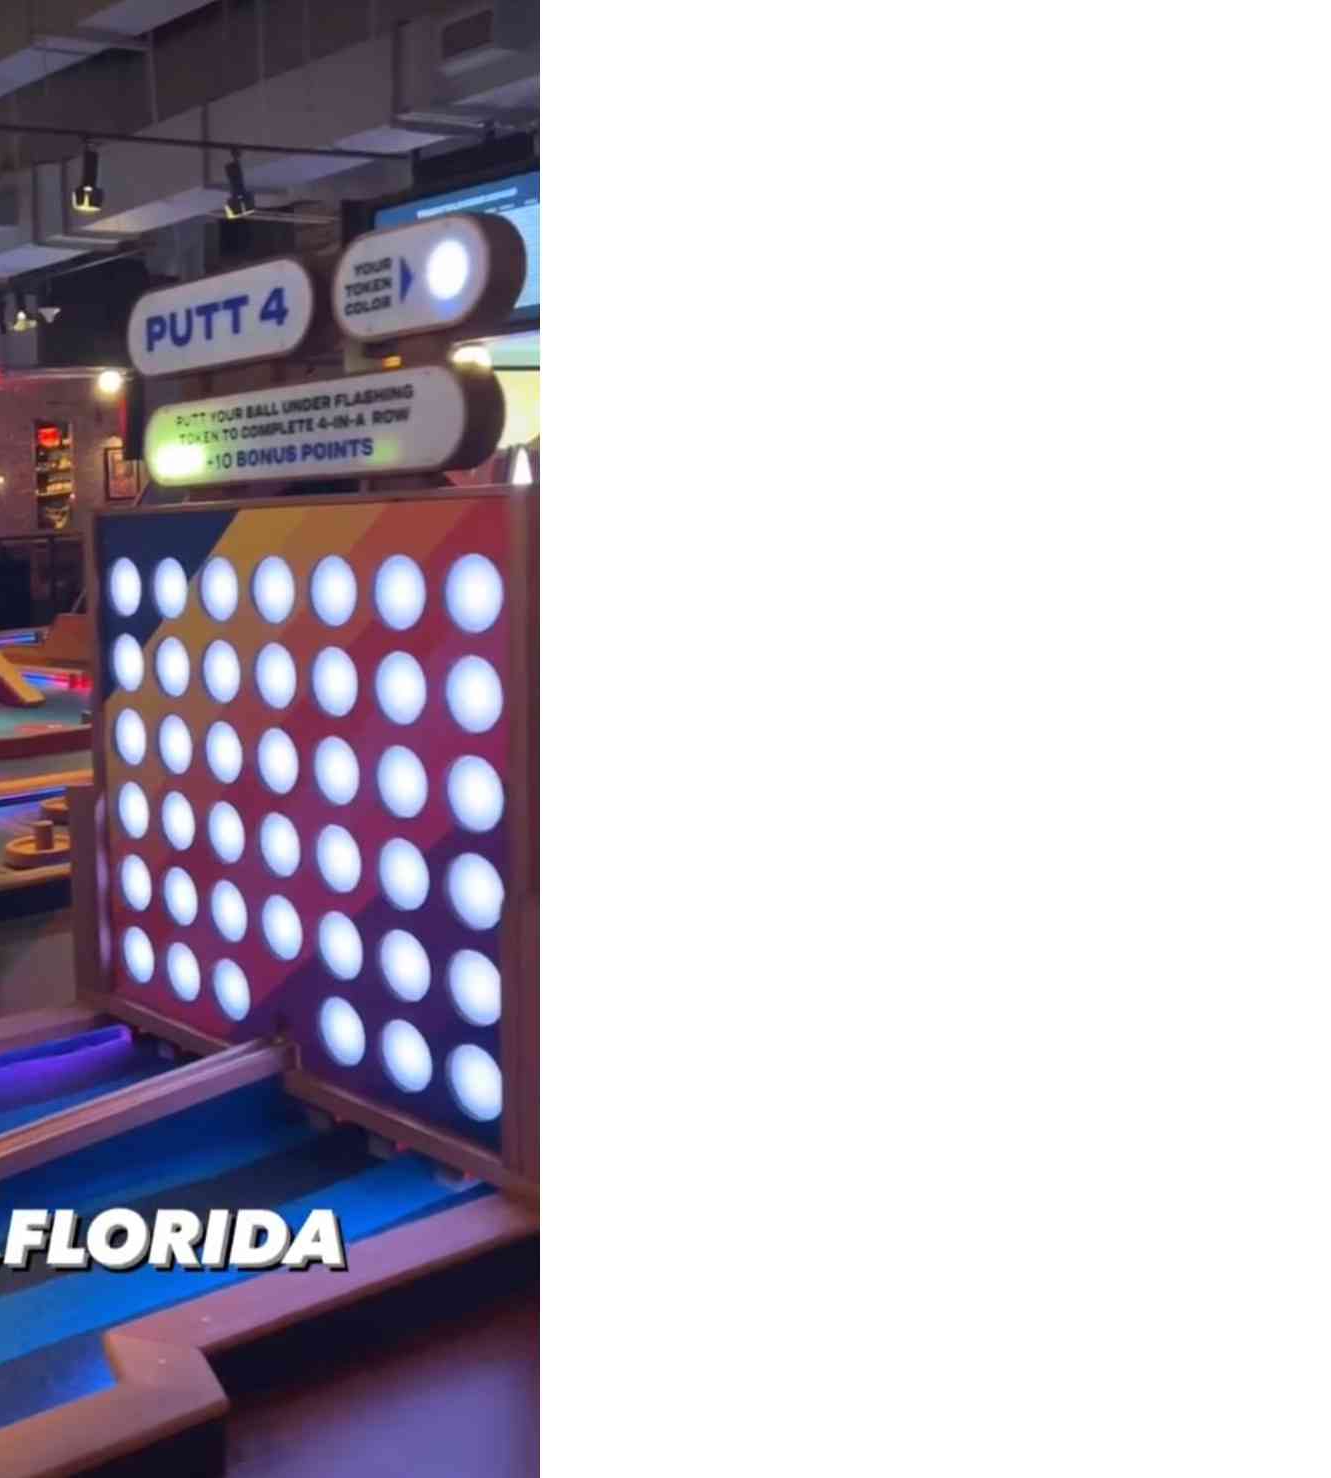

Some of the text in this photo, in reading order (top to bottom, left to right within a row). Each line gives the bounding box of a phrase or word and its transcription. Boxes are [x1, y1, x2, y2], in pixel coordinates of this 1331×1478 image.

[354, 256, 393, 276] YOUR
[344, 277, 393, 298] TOKEN
[145, 286, 289, 353] PUTT 4
[344, 294, 393, 317] COLOR
[175, 383, 414, 428] PUTT YOUR BALL UNDER FLASHING
[178, 406, 410, 446] TOKEN TO COMPLETE 4-IN-A ROW
[236, 444, 299, 469] BONUS
[301, 436, 375, 462] POINTS
